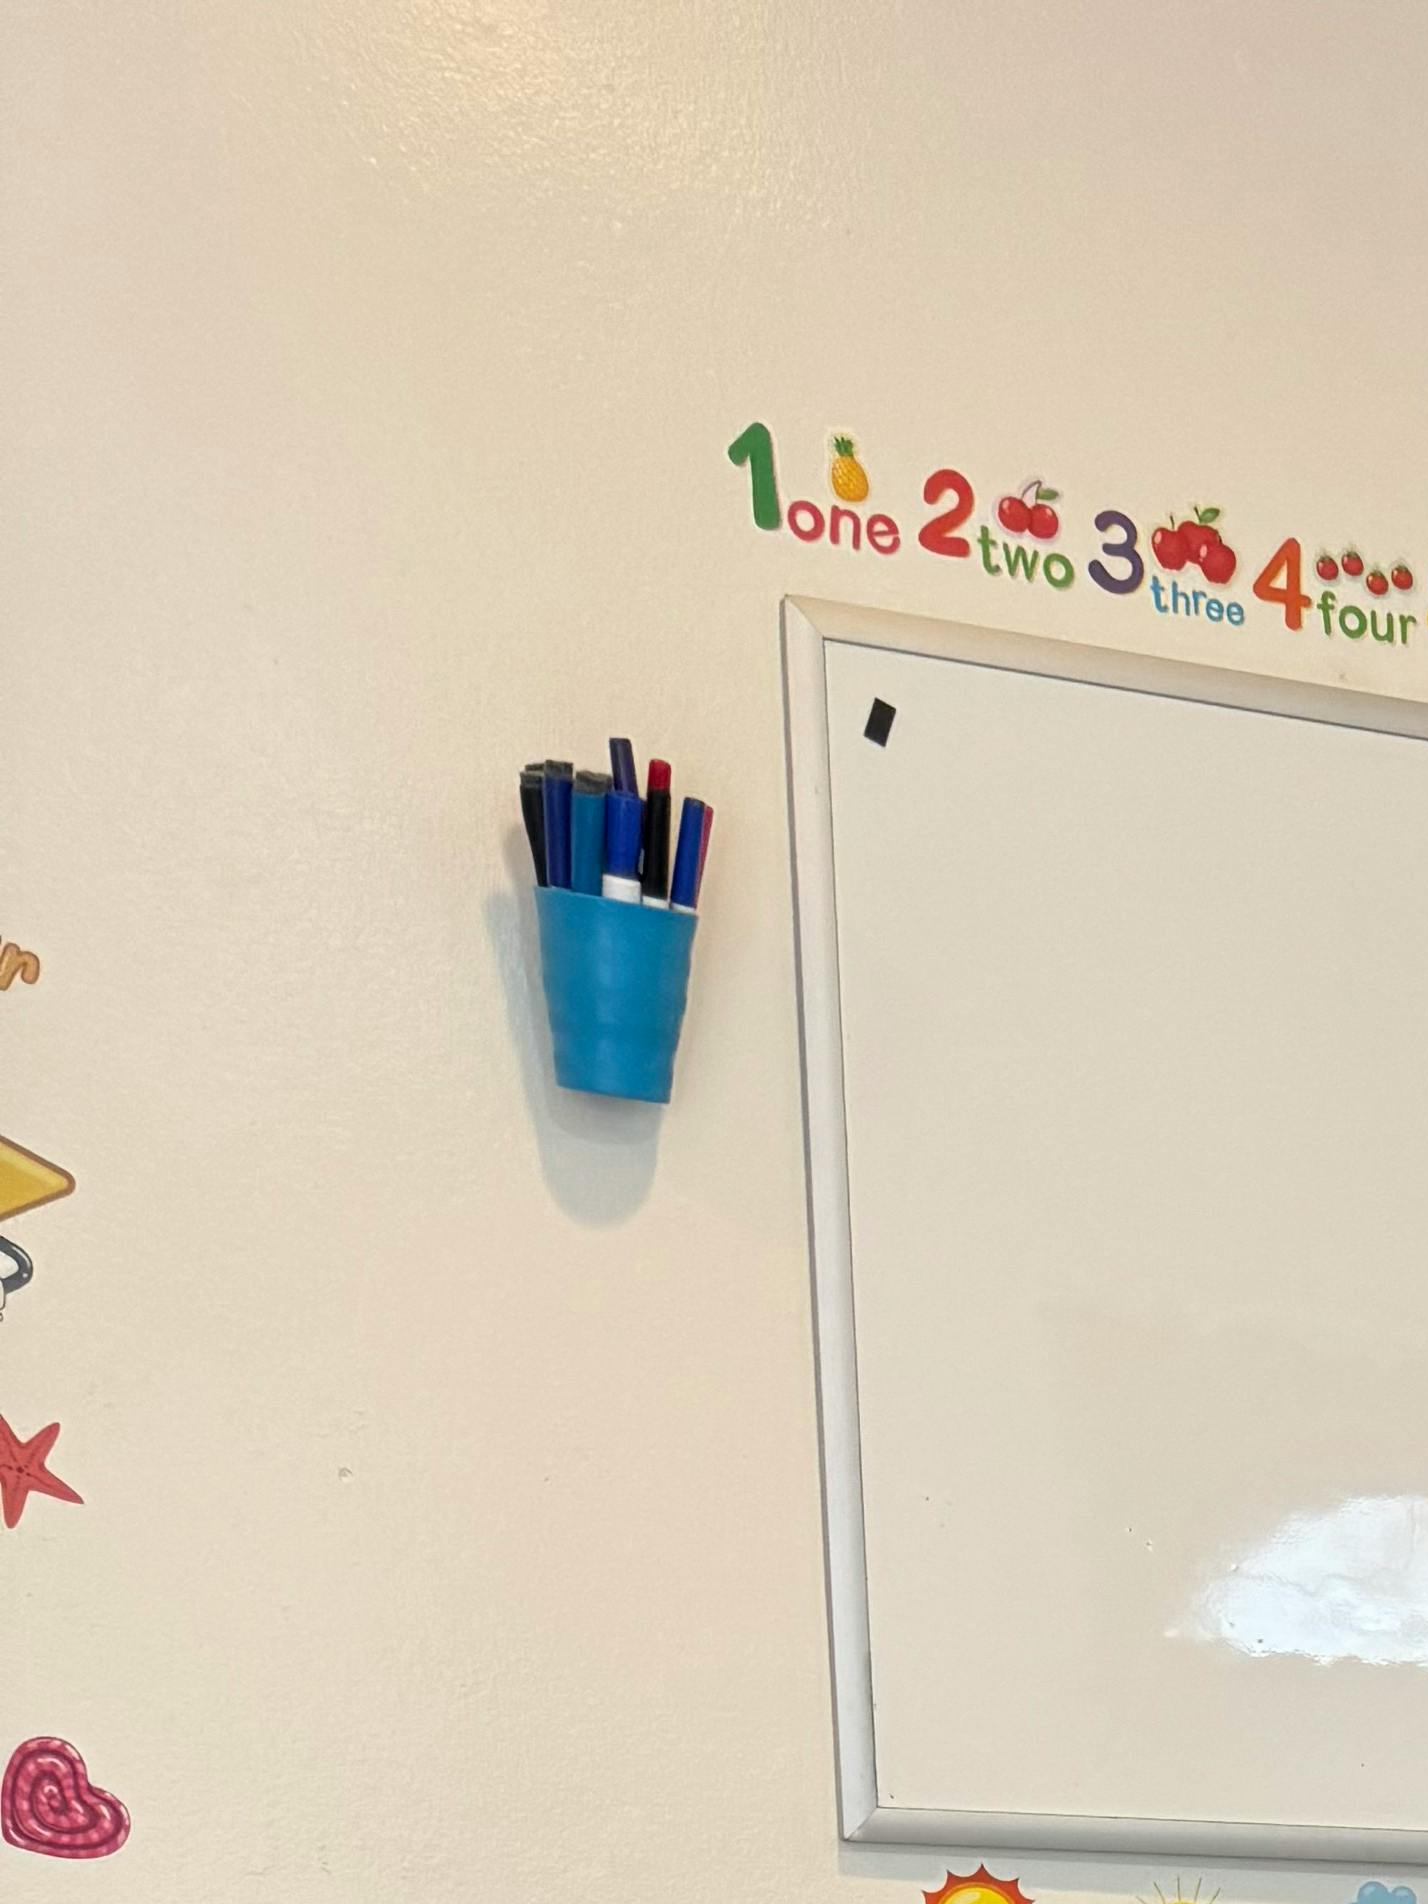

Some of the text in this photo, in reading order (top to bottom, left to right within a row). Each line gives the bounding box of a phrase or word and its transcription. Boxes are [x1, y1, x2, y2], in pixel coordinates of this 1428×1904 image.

[728, 422, 781, 530] 1
[786, 500, 902, 555] one
[918, 468, 974, 558] 2
[977, 525, 1075, 589] two
[1088, 510, 1144, 594] 3
[1149, 575, 1246, 626] three
[1252, 537, 1311, 632] 4
[1316, 590, 1417, 645] four
